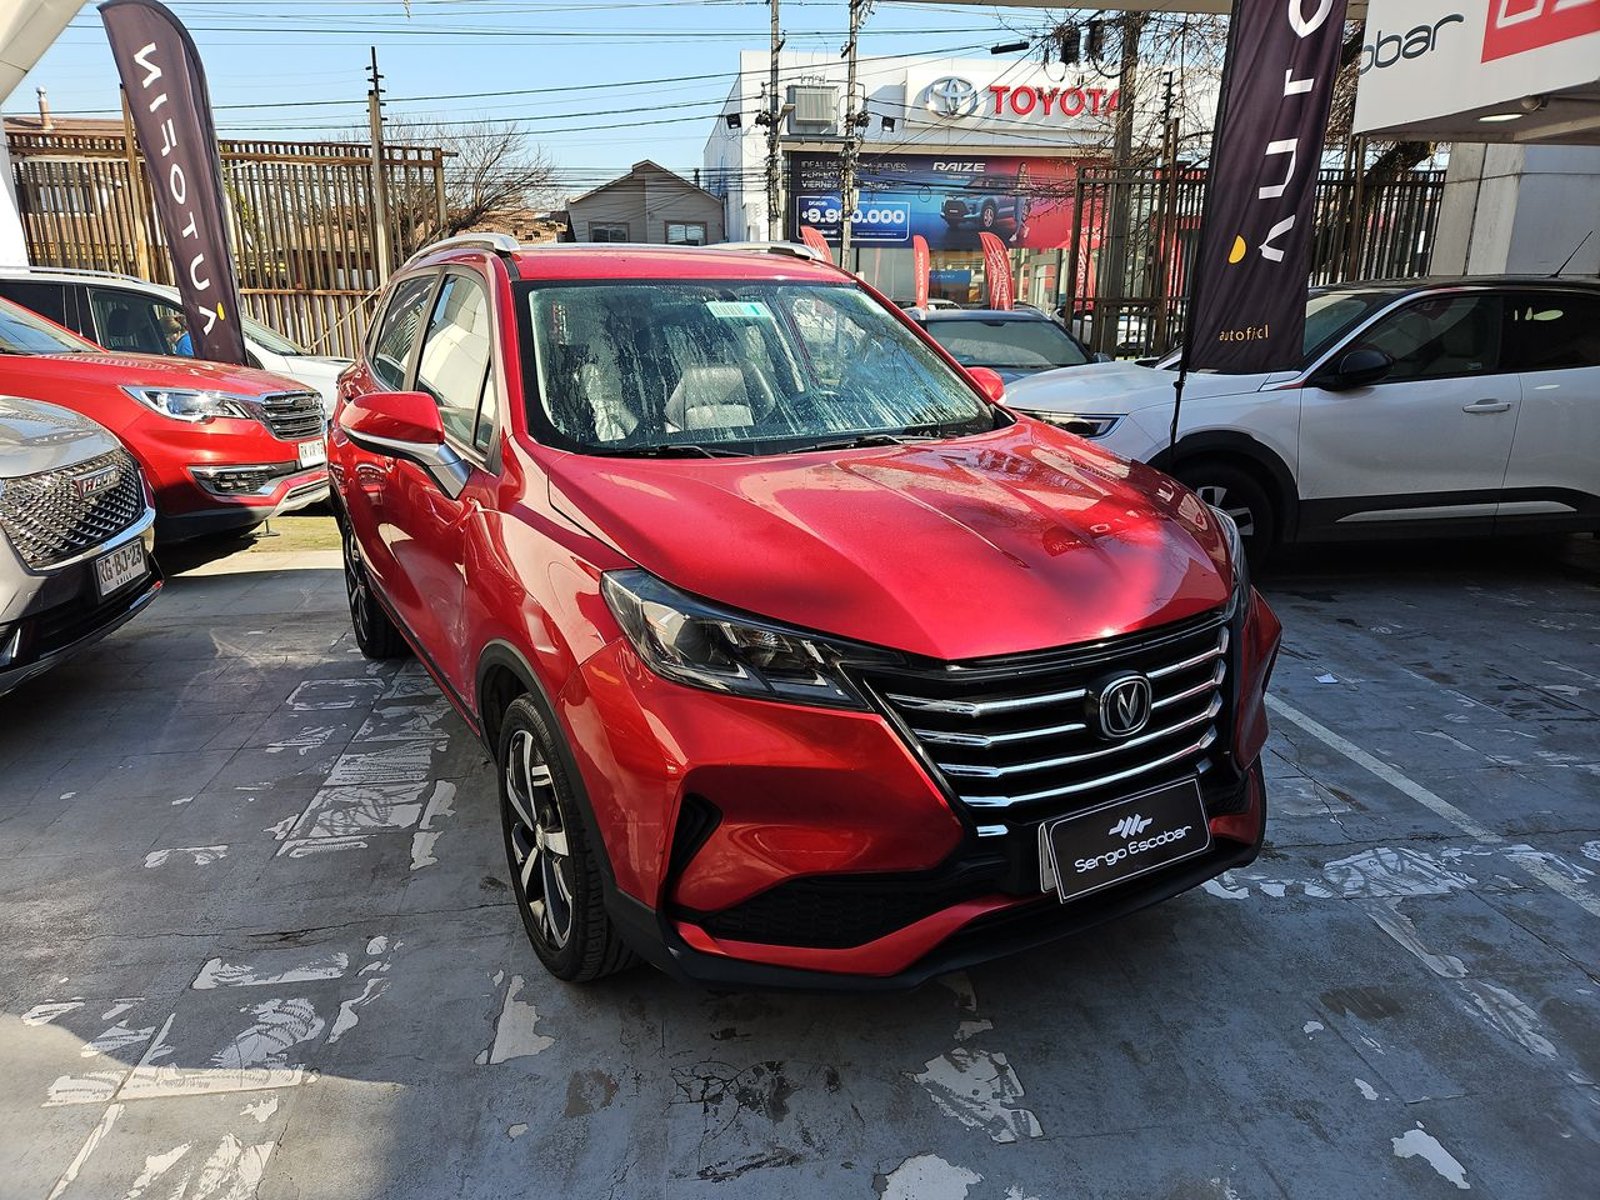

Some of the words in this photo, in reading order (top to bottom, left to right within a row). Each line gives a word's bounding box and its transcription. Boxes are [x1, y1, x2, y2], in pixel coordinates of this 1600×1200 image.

[932, 162, 986, 172] RAIZE
[802, 208, 906, 224] $9.90.000
[1074, 848, 1128, 873] Sergio
[1128, 825, 1192, 855] Escobar
